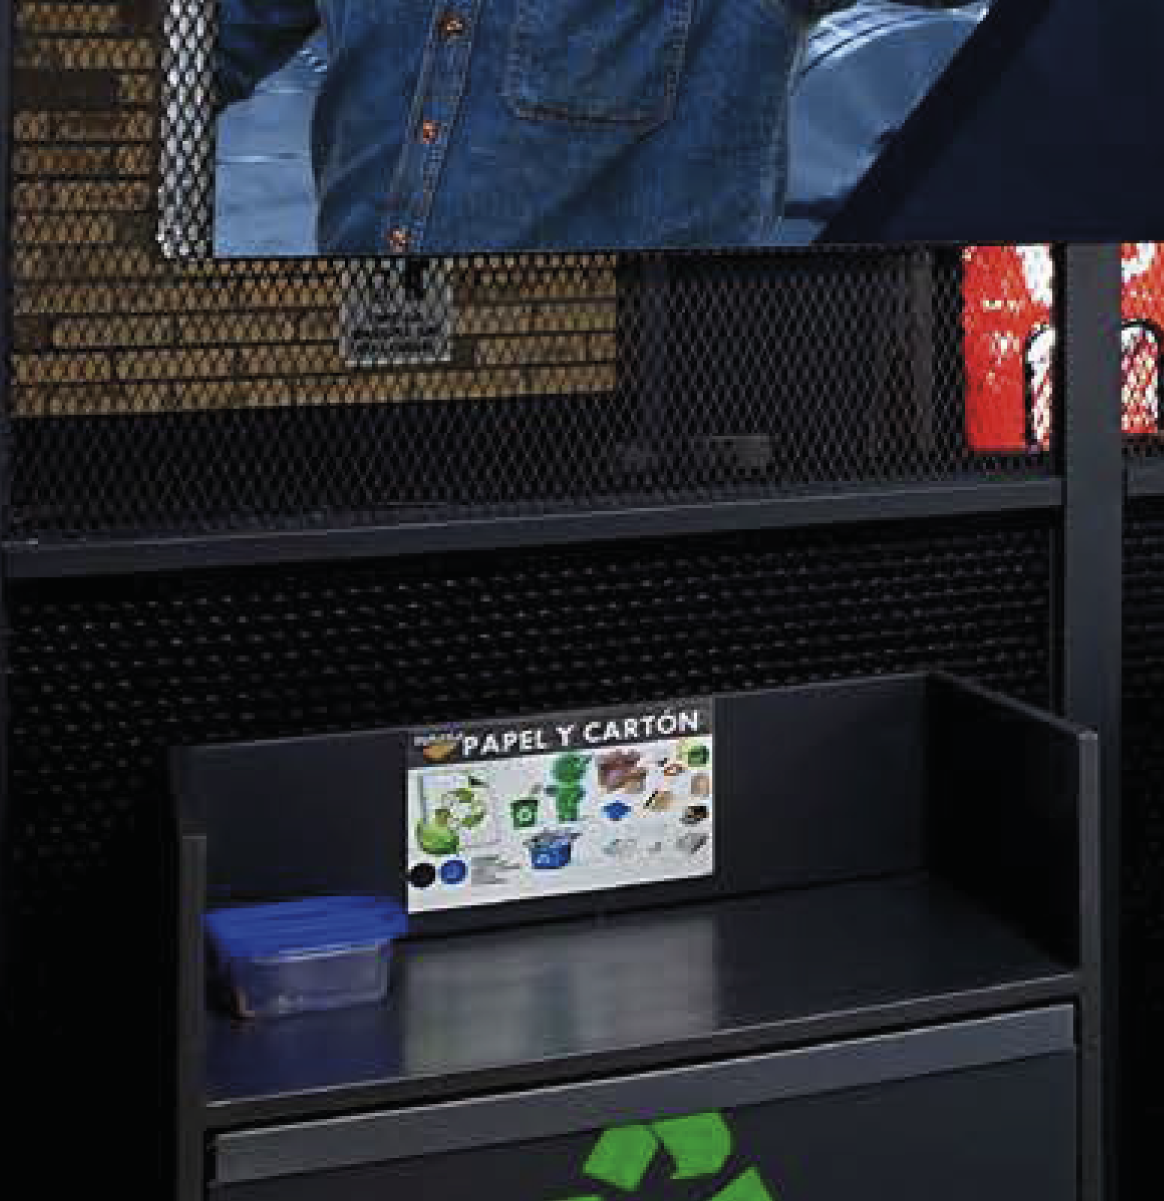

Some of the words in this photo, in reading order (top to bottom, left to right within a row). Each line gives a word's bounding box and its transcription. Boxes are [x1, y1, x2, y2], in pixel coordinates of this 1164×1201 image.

[462, 727, 547, 758] PAPEL
[555, 724, 575, 748] Y
[584, 708, 700, 744] CARTÓN
